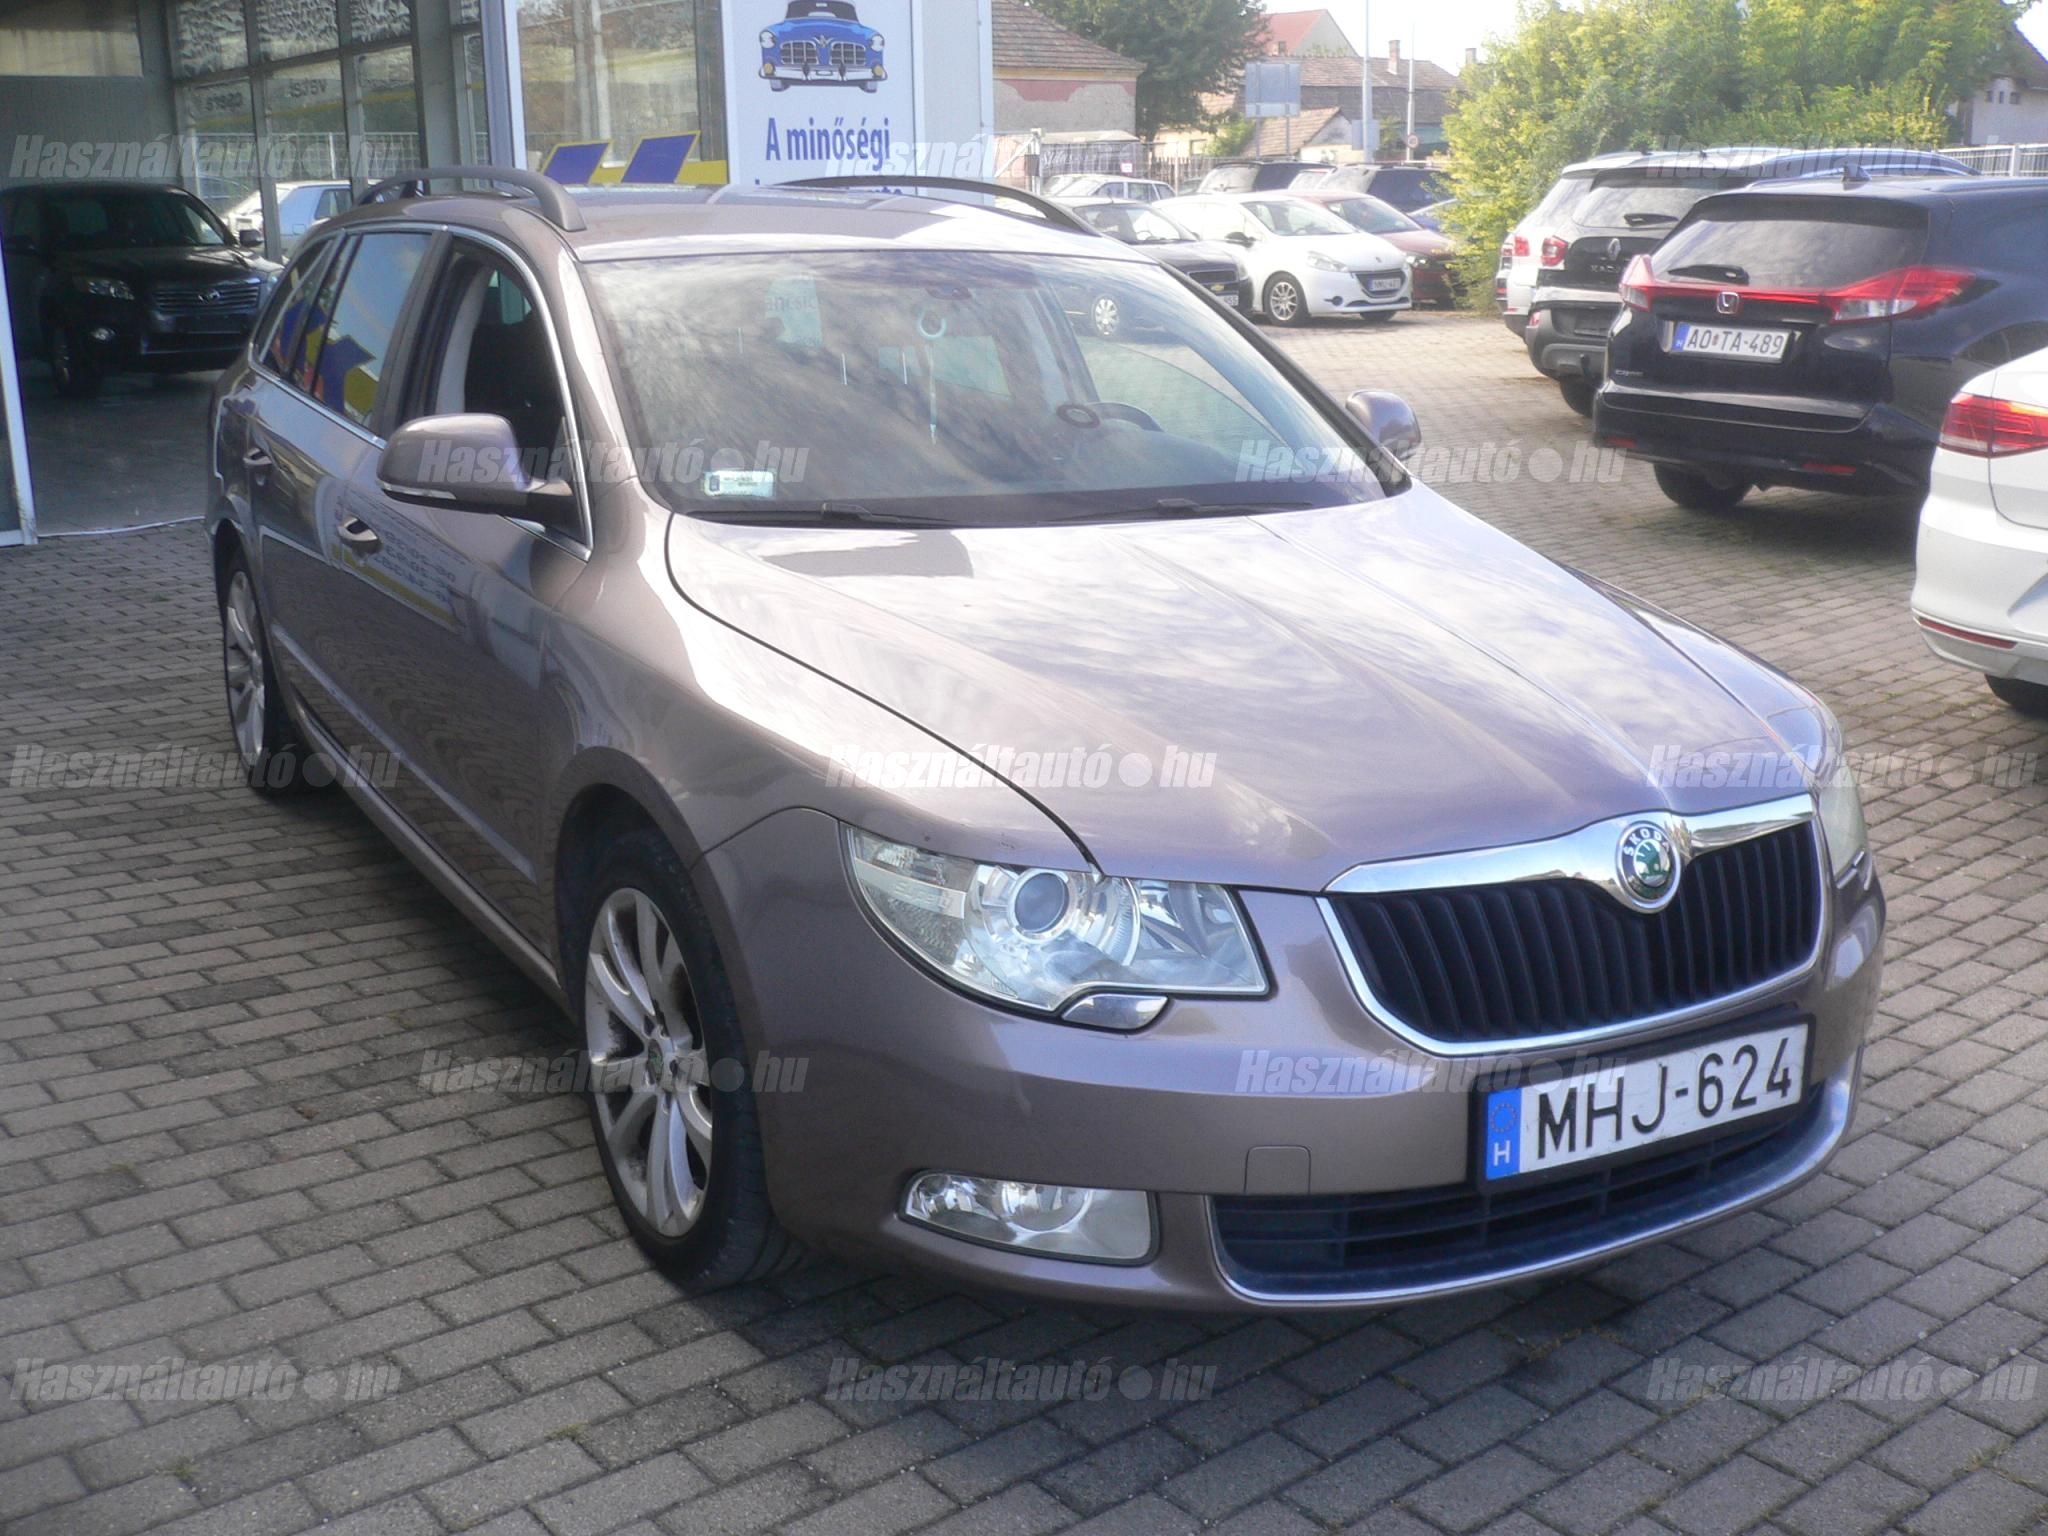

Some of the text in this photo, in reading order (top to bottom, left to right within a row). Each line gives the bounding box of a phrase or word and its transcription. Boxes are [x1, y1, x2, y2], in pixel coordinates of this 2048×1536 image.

[765, 116, 890, 172] A minőségi
[1537, 1037, 1792, 1161] MHJ-624
